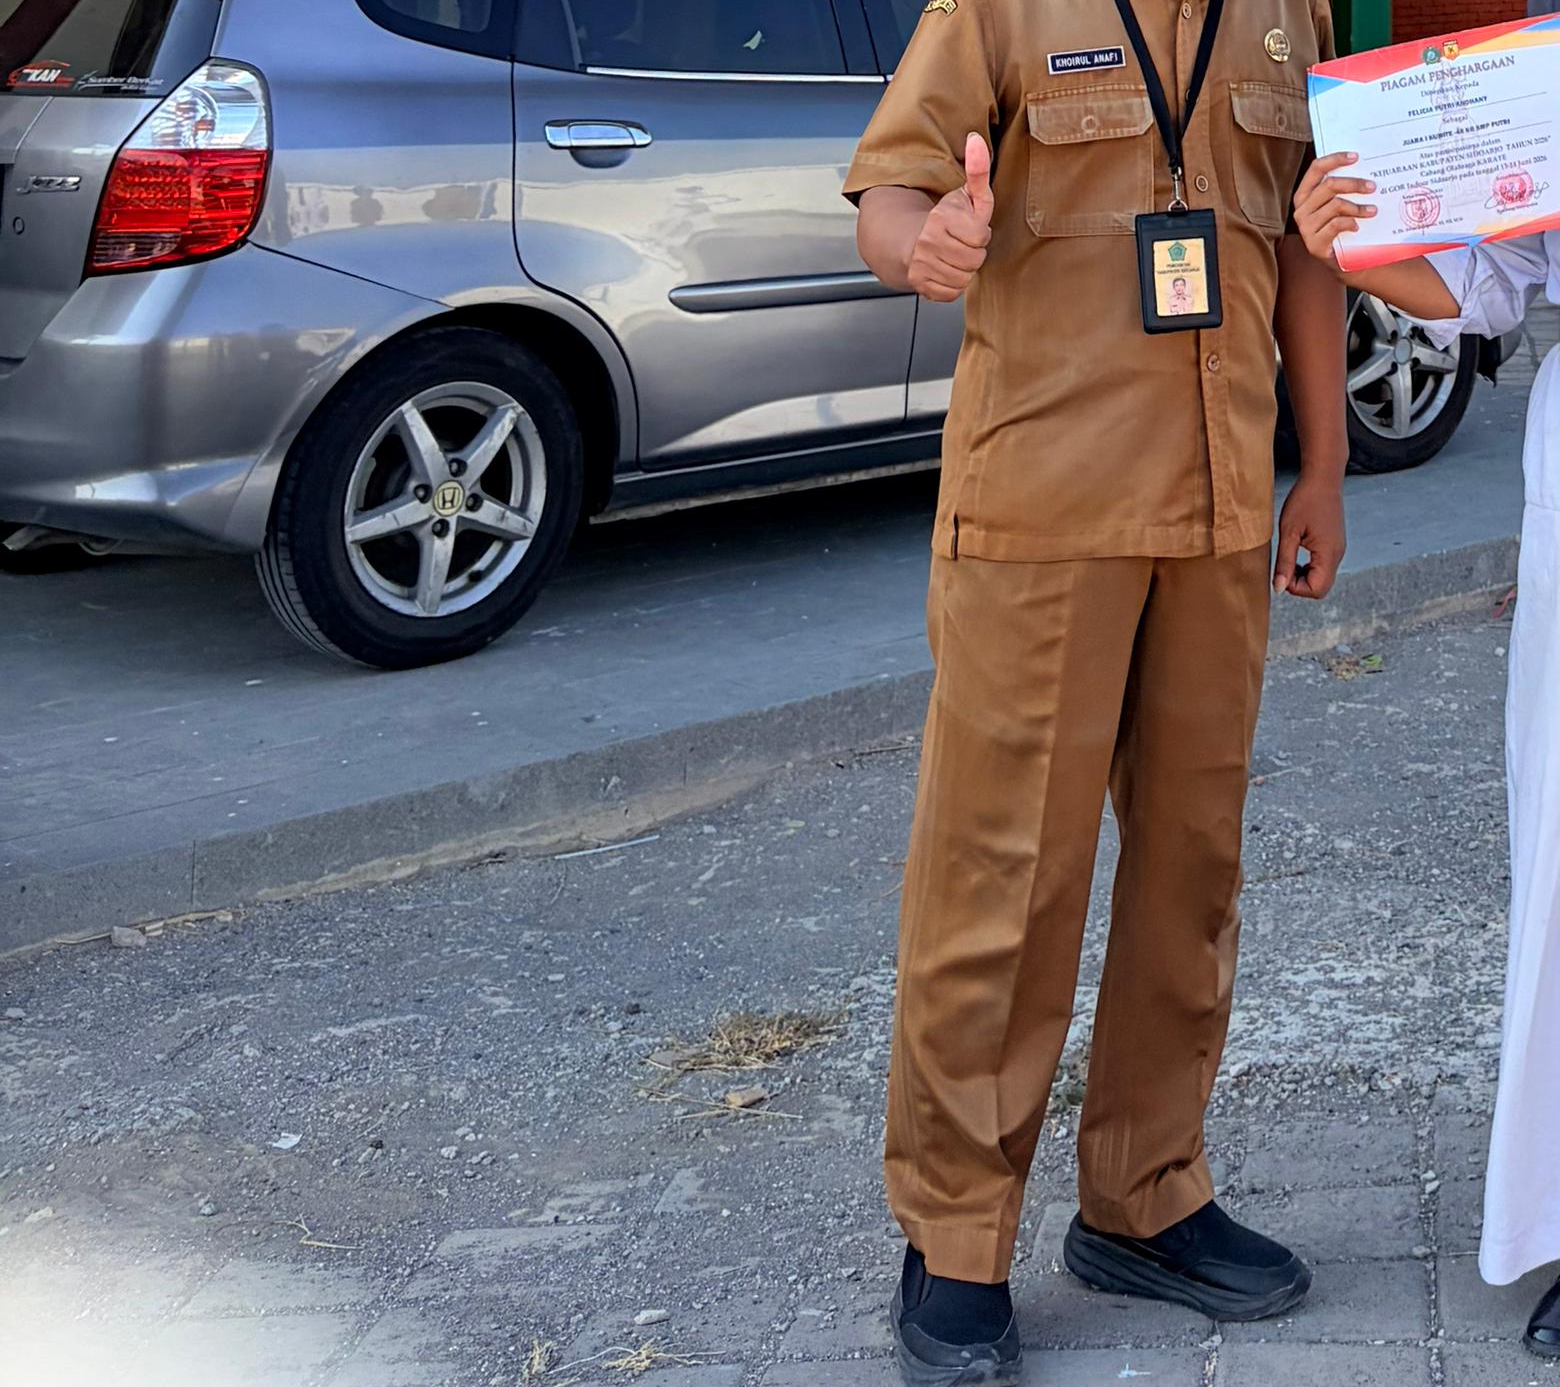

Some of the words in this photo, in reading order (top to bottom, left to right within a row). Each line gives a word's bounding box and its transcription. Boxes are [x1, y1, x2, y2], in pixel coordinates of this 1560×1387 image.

[1055, 56, 1091, 68] KHOIRUL
[1094, 52, 1118, 64] ANAFI
[1380, 73, 1426, 91] PIAGAM
[1429, 55, 1515, 82] PENGHARGAAN
[1408, 106, 1433, 116] FELICIA
[1435, 102, 1454, 111] PUTRI
[1443, 113, 1468, 125] Sebagai
[1403, 136, 1423, 146] JUARA
[1492, 118, 1510, 127] PUTRI
[1420, 153, 1466, 168] KABUPATEN
[1467, 145, 1504, 159] SIDOARJO
[1506, 139, 1533, 151] TAHUN
[1420, 166, 1445, 178] Cabang
[1477, 153, 1506, 166] KARATE
[1389, 183, 1406, 193] GOR
